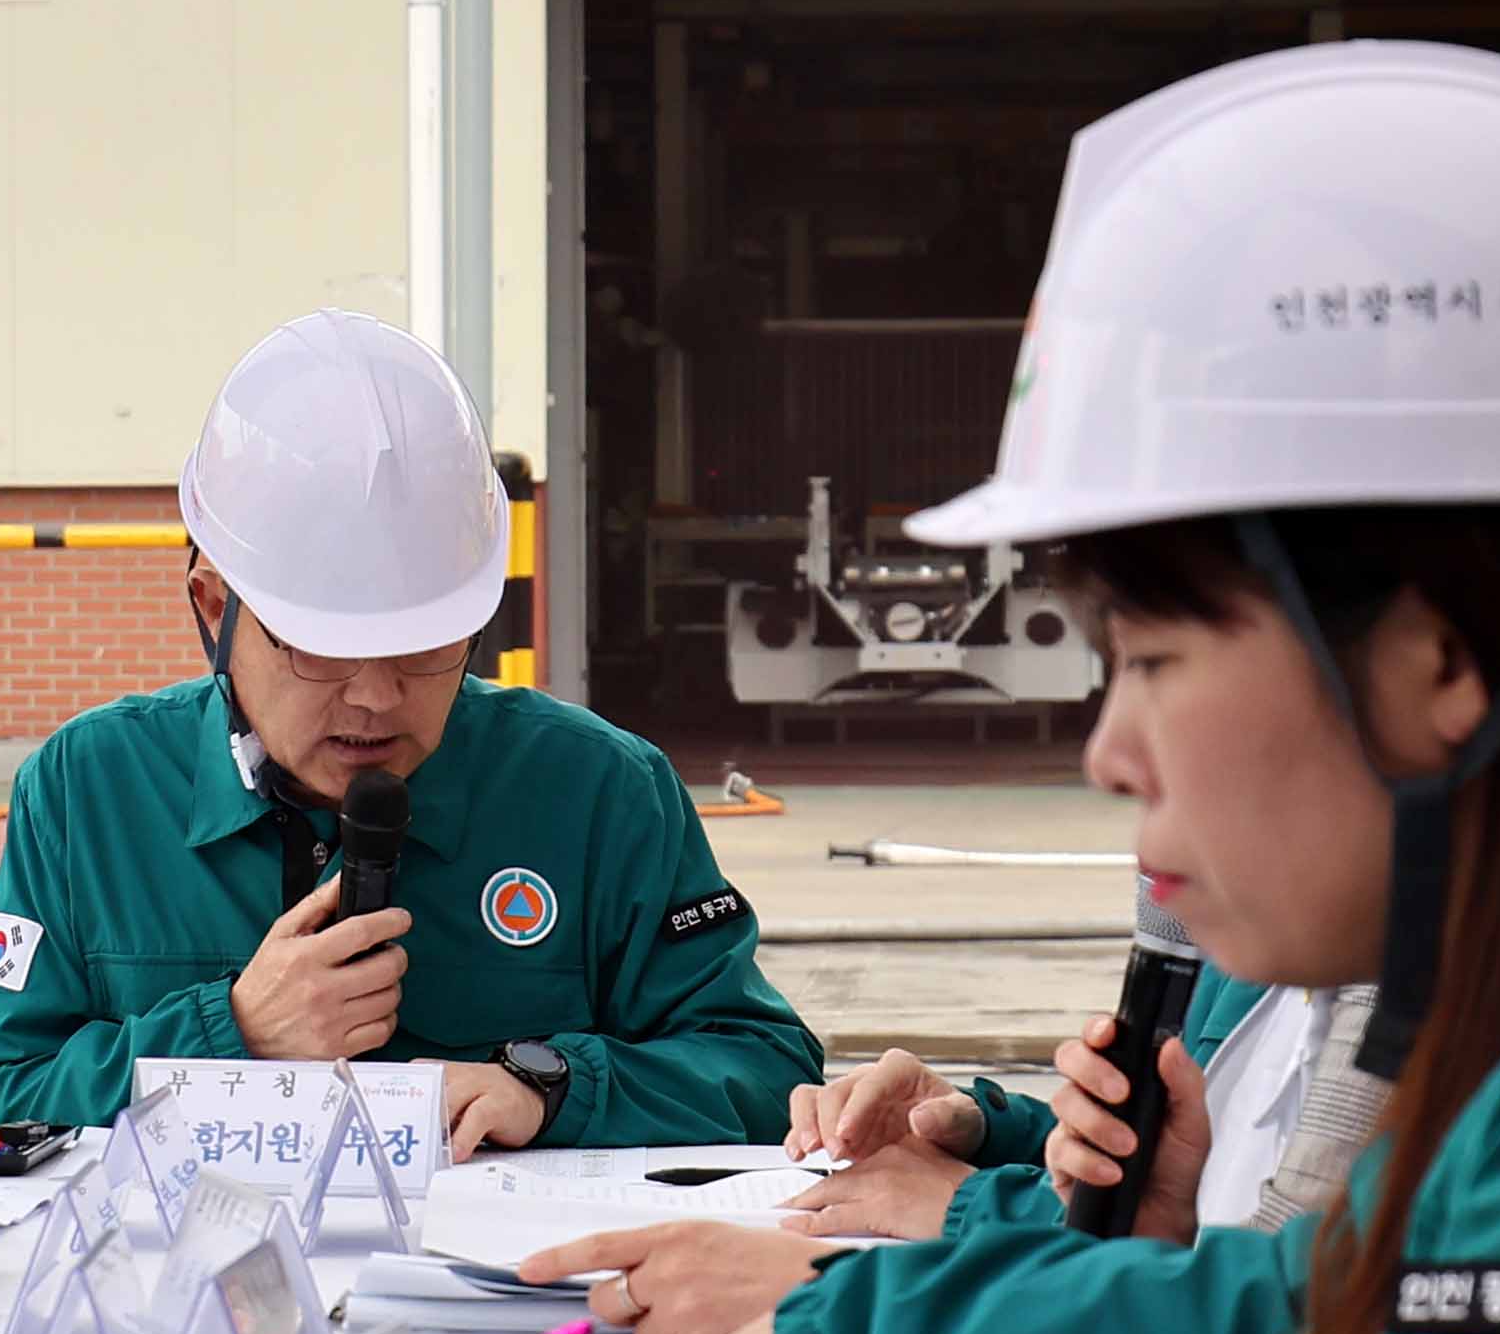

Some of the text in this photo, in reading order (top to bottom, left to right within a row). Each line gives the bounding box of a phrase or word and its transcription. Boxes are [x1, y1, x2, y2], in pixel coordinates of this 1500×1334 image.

[1270, 279, 1482, 335] 인천광역시
[672, 894, 738, 931] 인천 동구청
[168, 1069, 296, 1098] 부구청
